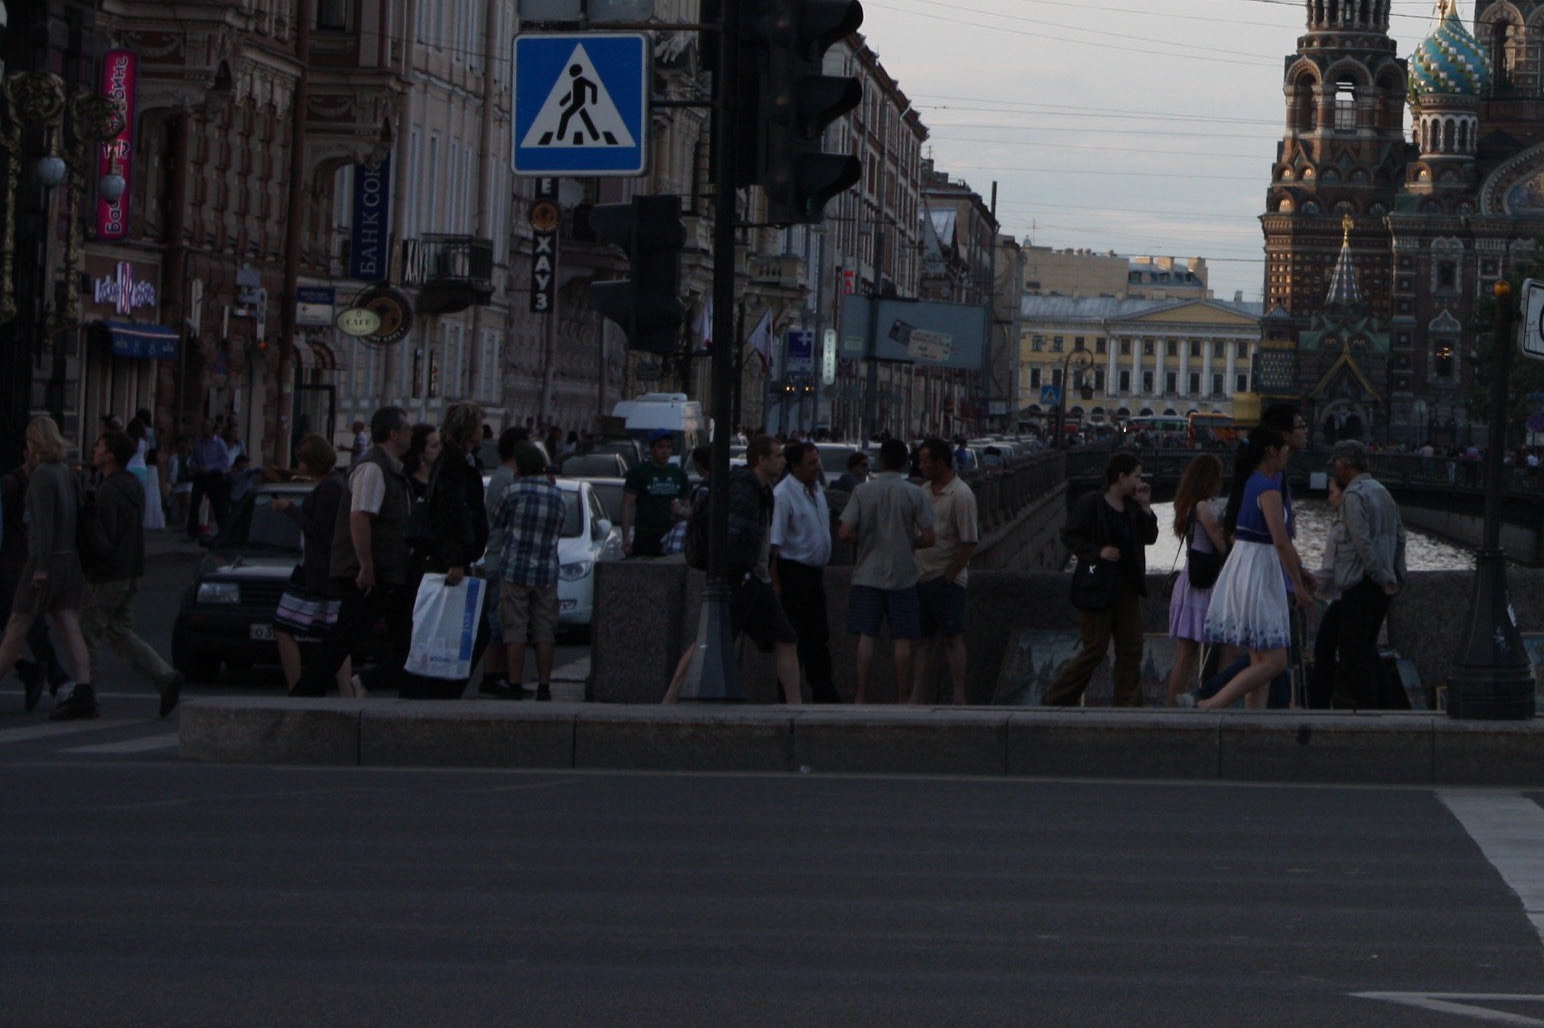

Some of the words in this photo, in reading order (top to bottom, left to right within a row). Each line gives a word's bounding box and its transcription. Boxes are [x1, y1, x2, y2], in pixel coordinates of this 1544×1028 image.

[363, 161, 381, 207] СОЮ
[360, 211, 379, 275] БАНК
[405, 239, 428, 285] ХАУЗ
[534, 236, 553, 310] ХАУЗ
